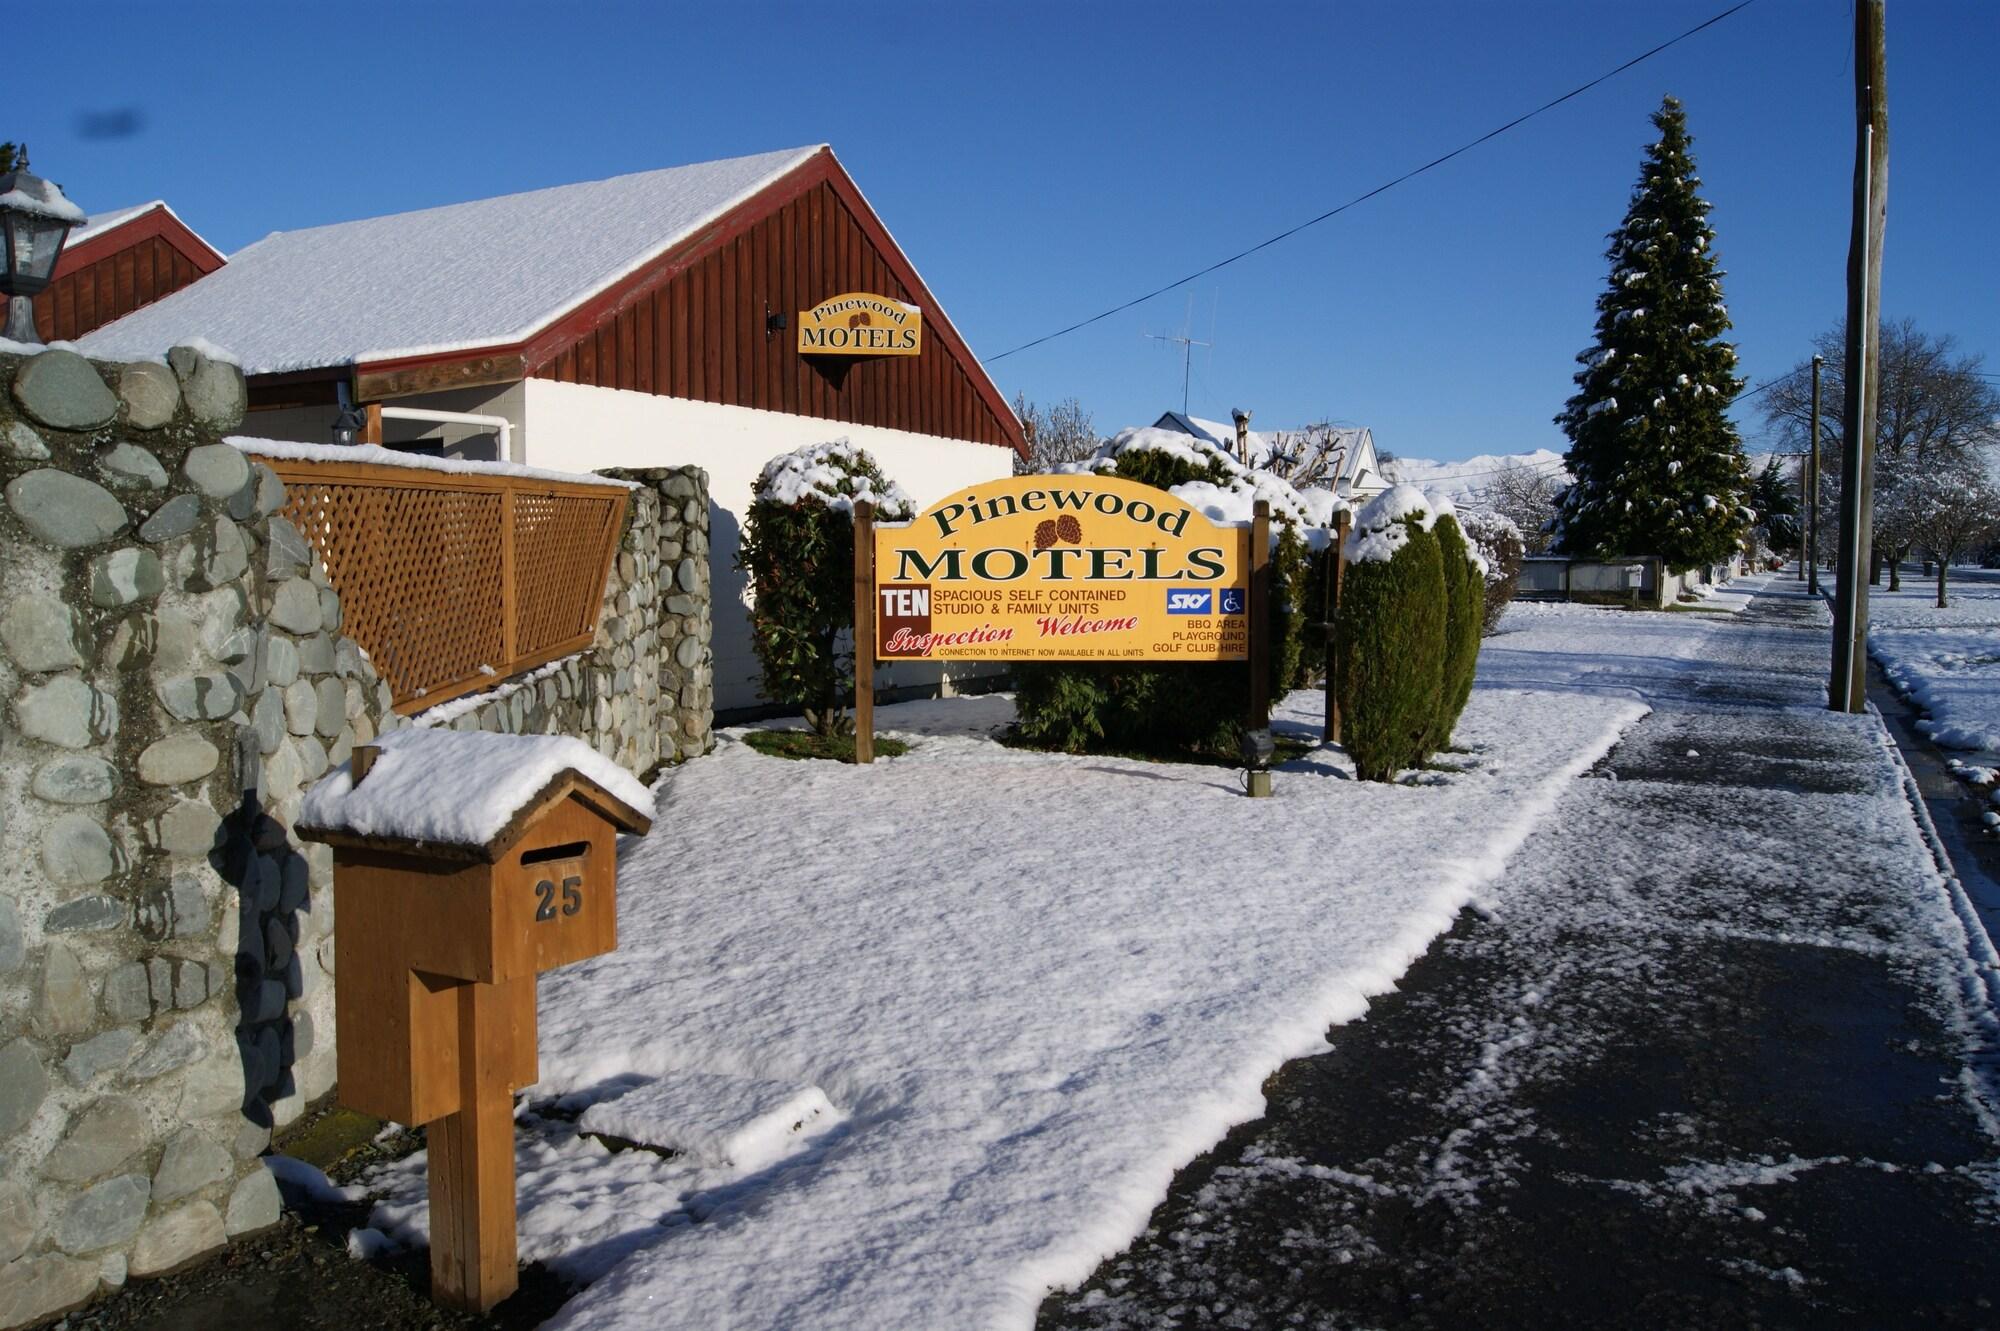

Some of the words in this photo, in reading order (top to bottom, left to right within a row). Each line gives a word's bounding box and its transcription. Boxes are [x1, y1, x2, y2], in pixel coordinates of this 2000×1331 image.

[812, 299, 906, 325] Pinewood
[802, 327, 916, 349] MOTELS
[929, 489, 1191, 540] Pinewood
[892, 548, 1226, 581] MOTELS
[880, 589, 929, 617] TEN
[933, 590, 1002, 601] SPACIOUS
[1009, 589, 1043, 601] SELF
[1049, 589, 1127, 601] CONTAINED
[1168, 594, 1211, 609] SKY
[933, 603, 985, 615] STUDIO
[991, 603, 1000, 615] &
[1007, 603, 1053, 615] FAMILY
[1058, 603, 1100, 615] UNITS
[1187, 619, 1211, 630] BBQ
[1216, 619, 1246, 630] AREA
[885, 623, 1014, 657] Inspection
[1036, 614, 1138, 638] Welcome
[1172, 631, 1246, 641] PLAYGROUND
[939, 648, 986, 656] CONNECTION
[989, 648, 999, 656] TO
[1001, 648, 1035, 657] INTERNET
[1038, 648, 1055, 657] NOW
[1057, 648, 1095, 657] AVAILABLE
[1097, 649, 1105, 657] IN
[1107, 649, 1121, 657] ALL
[1122, 648, 1145, 657] UNITS
[1152, 643, 1182, 653] GOLF
[1187, 643, 1216, 653] CLUB
[1221, 643, 1246, 653] HIRE
[535, 875, 582, 922] 25
